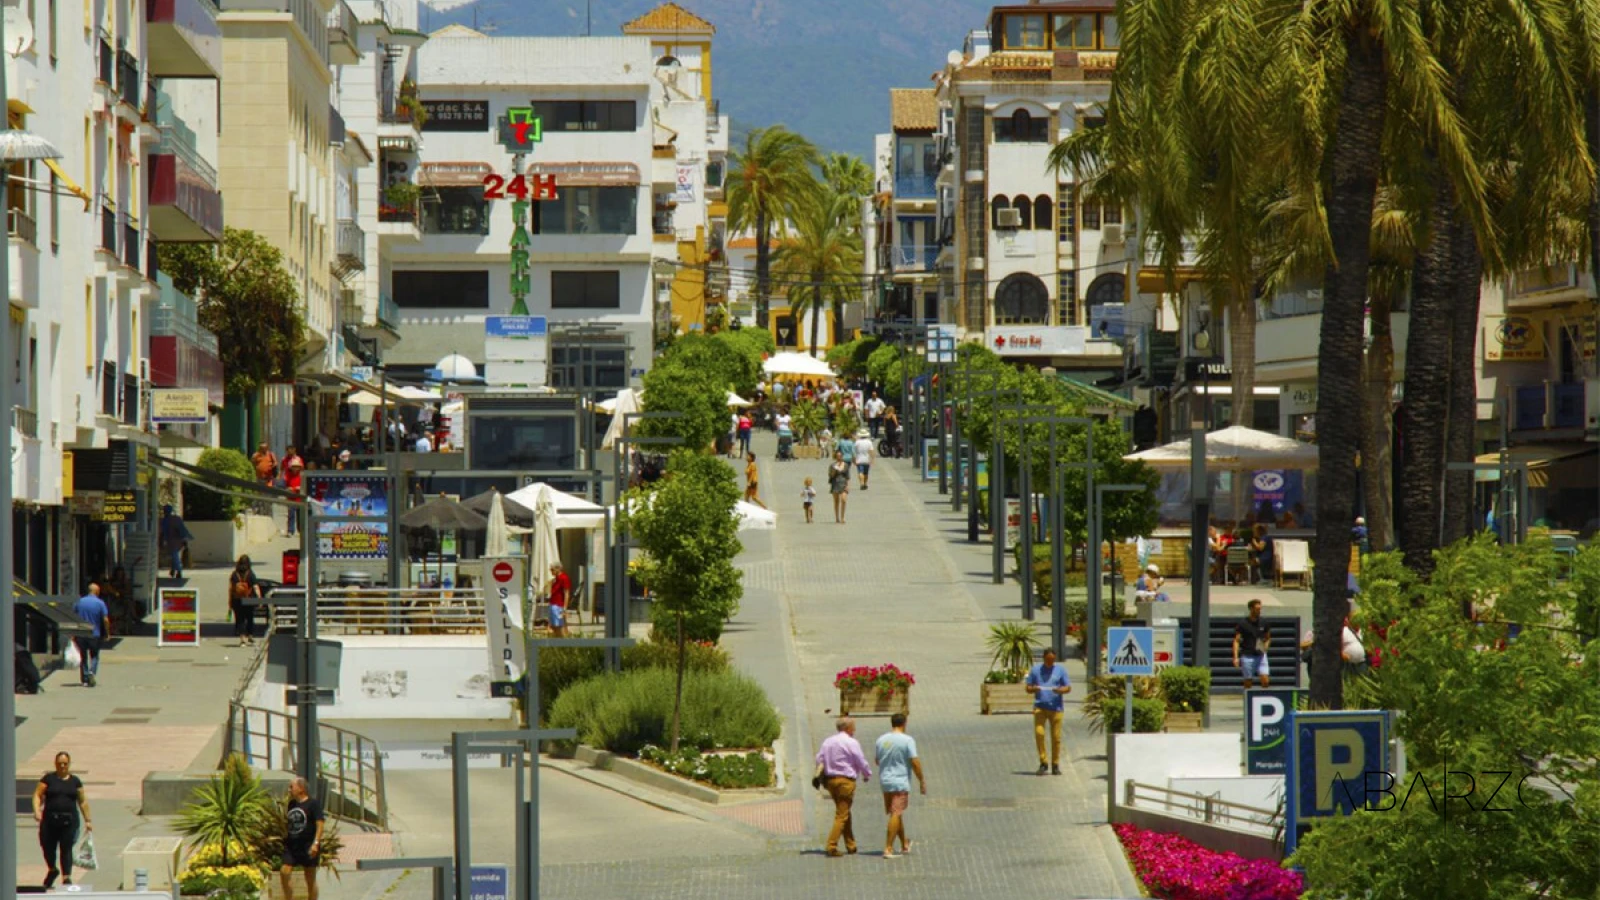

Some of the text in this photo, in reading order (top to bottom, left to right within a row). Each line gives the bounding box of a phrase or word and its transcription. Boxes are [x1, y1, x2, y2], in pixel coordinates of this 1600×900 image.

[483, 173, 557, 199] 24H
[499, 586, 513, 676] SALIDA
[1252, 696, 1285, 742] P
[1315, 729, 1366, 811] P
